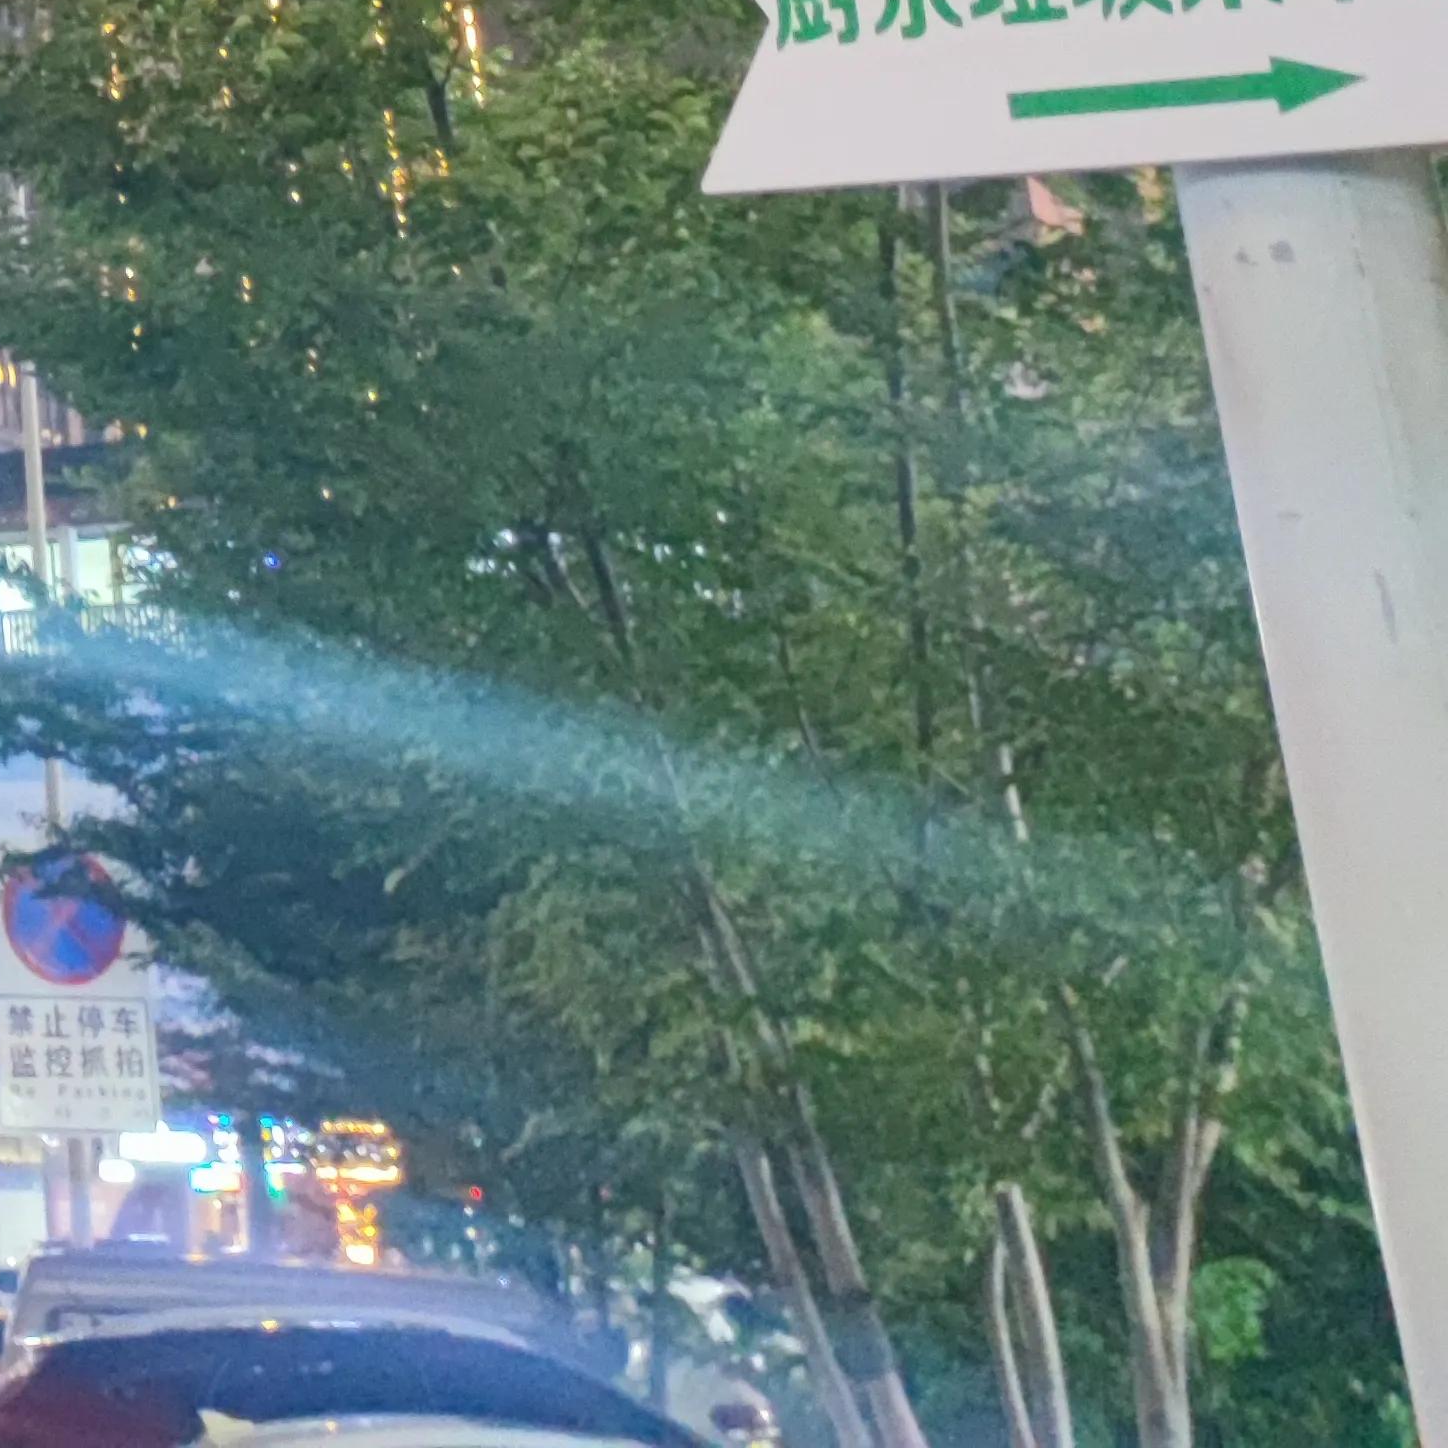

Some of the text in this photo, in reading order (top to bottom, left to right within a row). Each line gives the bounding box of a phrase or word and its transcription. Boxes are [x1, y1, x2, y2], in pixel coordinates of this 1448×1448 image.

[9, 1003, 141, 1038] 禁止停车
[10, 1044, 147, 1080] 监控抓拍
